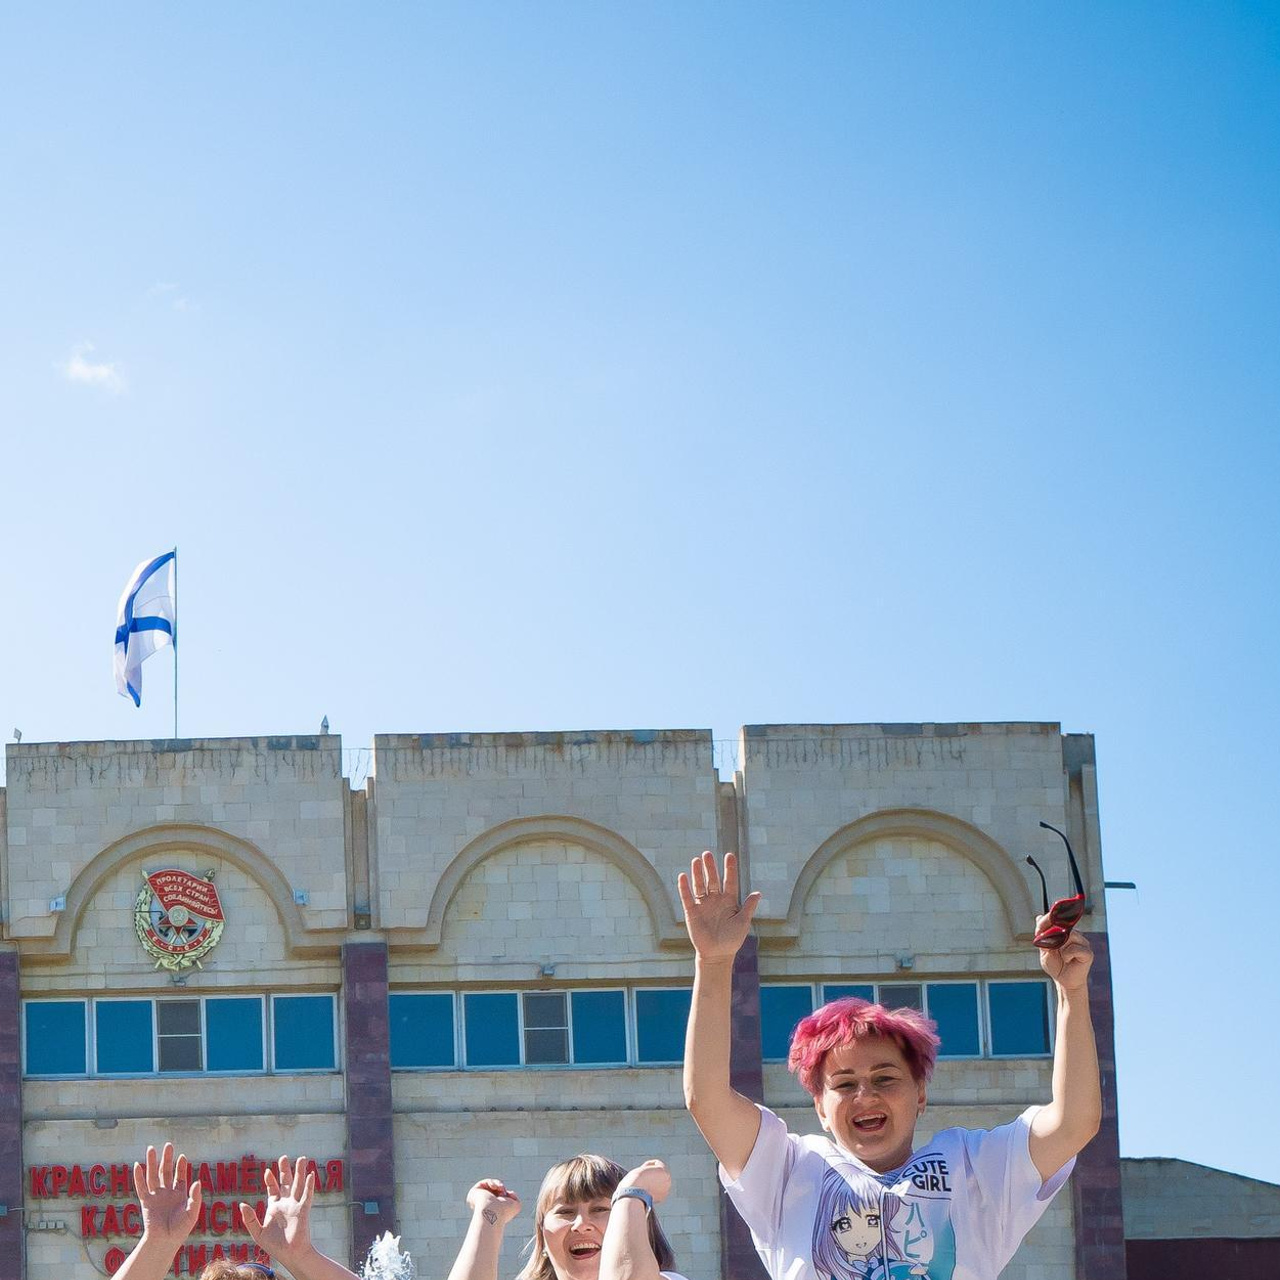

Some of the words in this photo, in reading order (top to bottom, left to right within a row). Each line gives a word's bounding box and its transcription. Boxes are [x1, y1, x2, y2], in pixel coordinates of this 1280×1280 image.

[156, 875, 208, 893] ПРОЛЕТАРИИ
[163, 884, 183, 892] ВСЕХ
[902, 1159, 949, 1178] CUTE
[912, 1174, 952, 1192] GIRL
